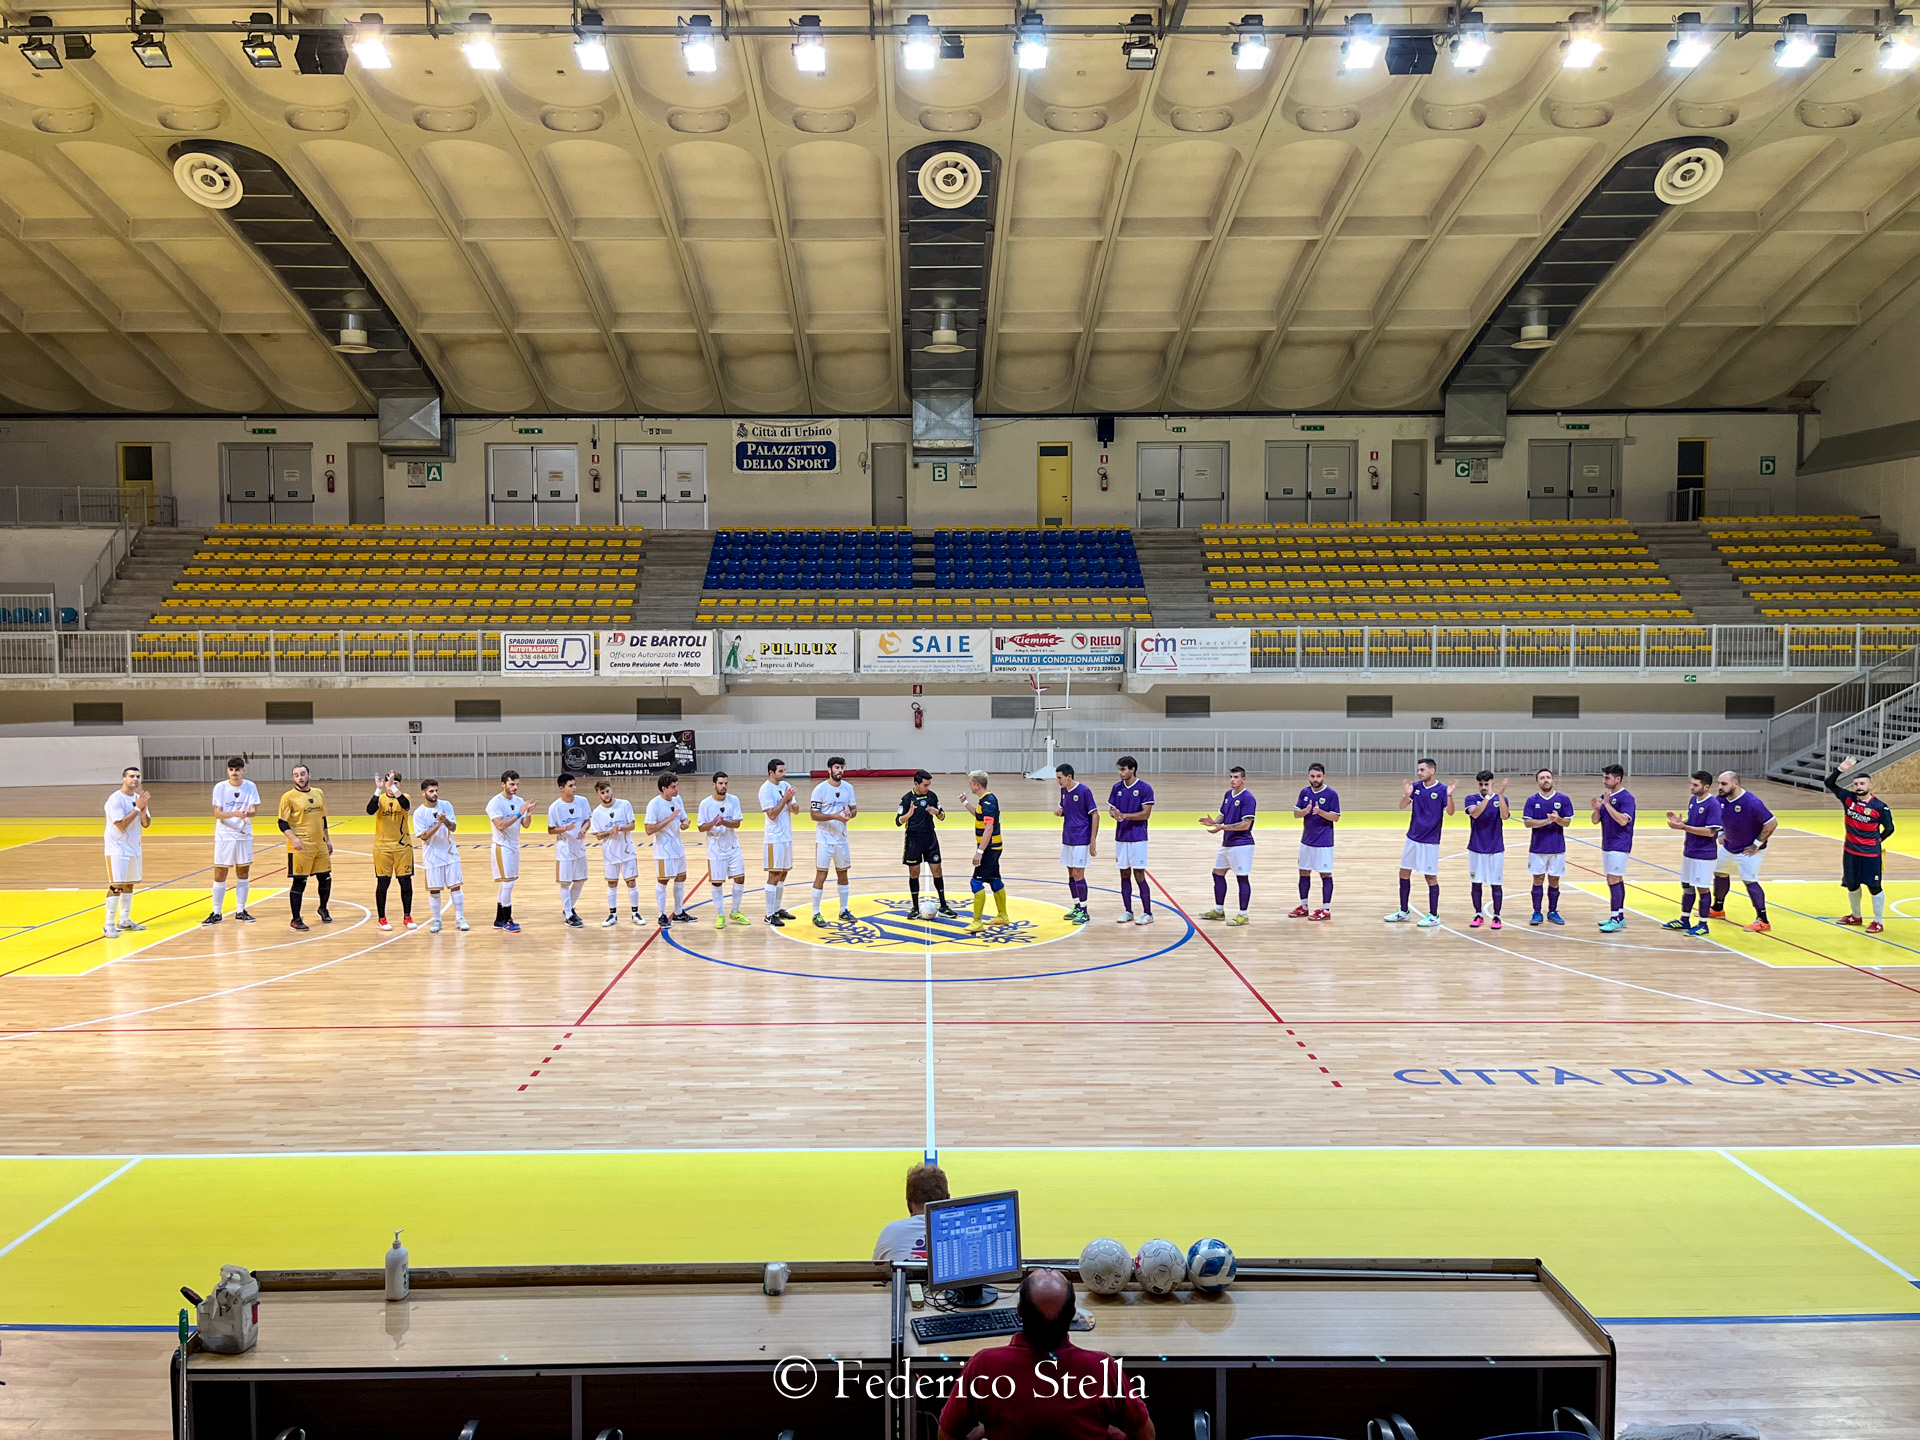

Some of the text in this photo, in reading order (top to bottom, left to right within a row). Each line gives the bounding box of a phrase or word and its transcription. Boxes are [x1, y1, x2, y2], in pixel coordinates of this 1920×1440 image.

[752, 427, 832, 437] Città di Urbino
[1456, 463, 1469, 476] C
[1762, 460, 1774, 474] D
[428, 466, 440, 480] A
[934, 468, 946, 480] B
[630, 636, 707, 647] DE BARTOLI
[912, 636, 970, 652] SAIE
[1014, 636, 1055, 644] Tiemme
[1090, 636, 1121, 646] RIELLO
[1180, 638, 1196, 646] cm
[760, 643, 837, 655] PULILUX
[610, 651, 636, 660] Officina
[994, 656, 1121, 664] IMPIANTI DI CONDIZIONAMENTO
[579, 734, 678, 745] LOCANDA DELLA
[598, 750, 659, 760] STAZIONE
[1393, 1066, 1605, 1085] CITTÀ
[1610, 1068, 1694, 1085] DI
